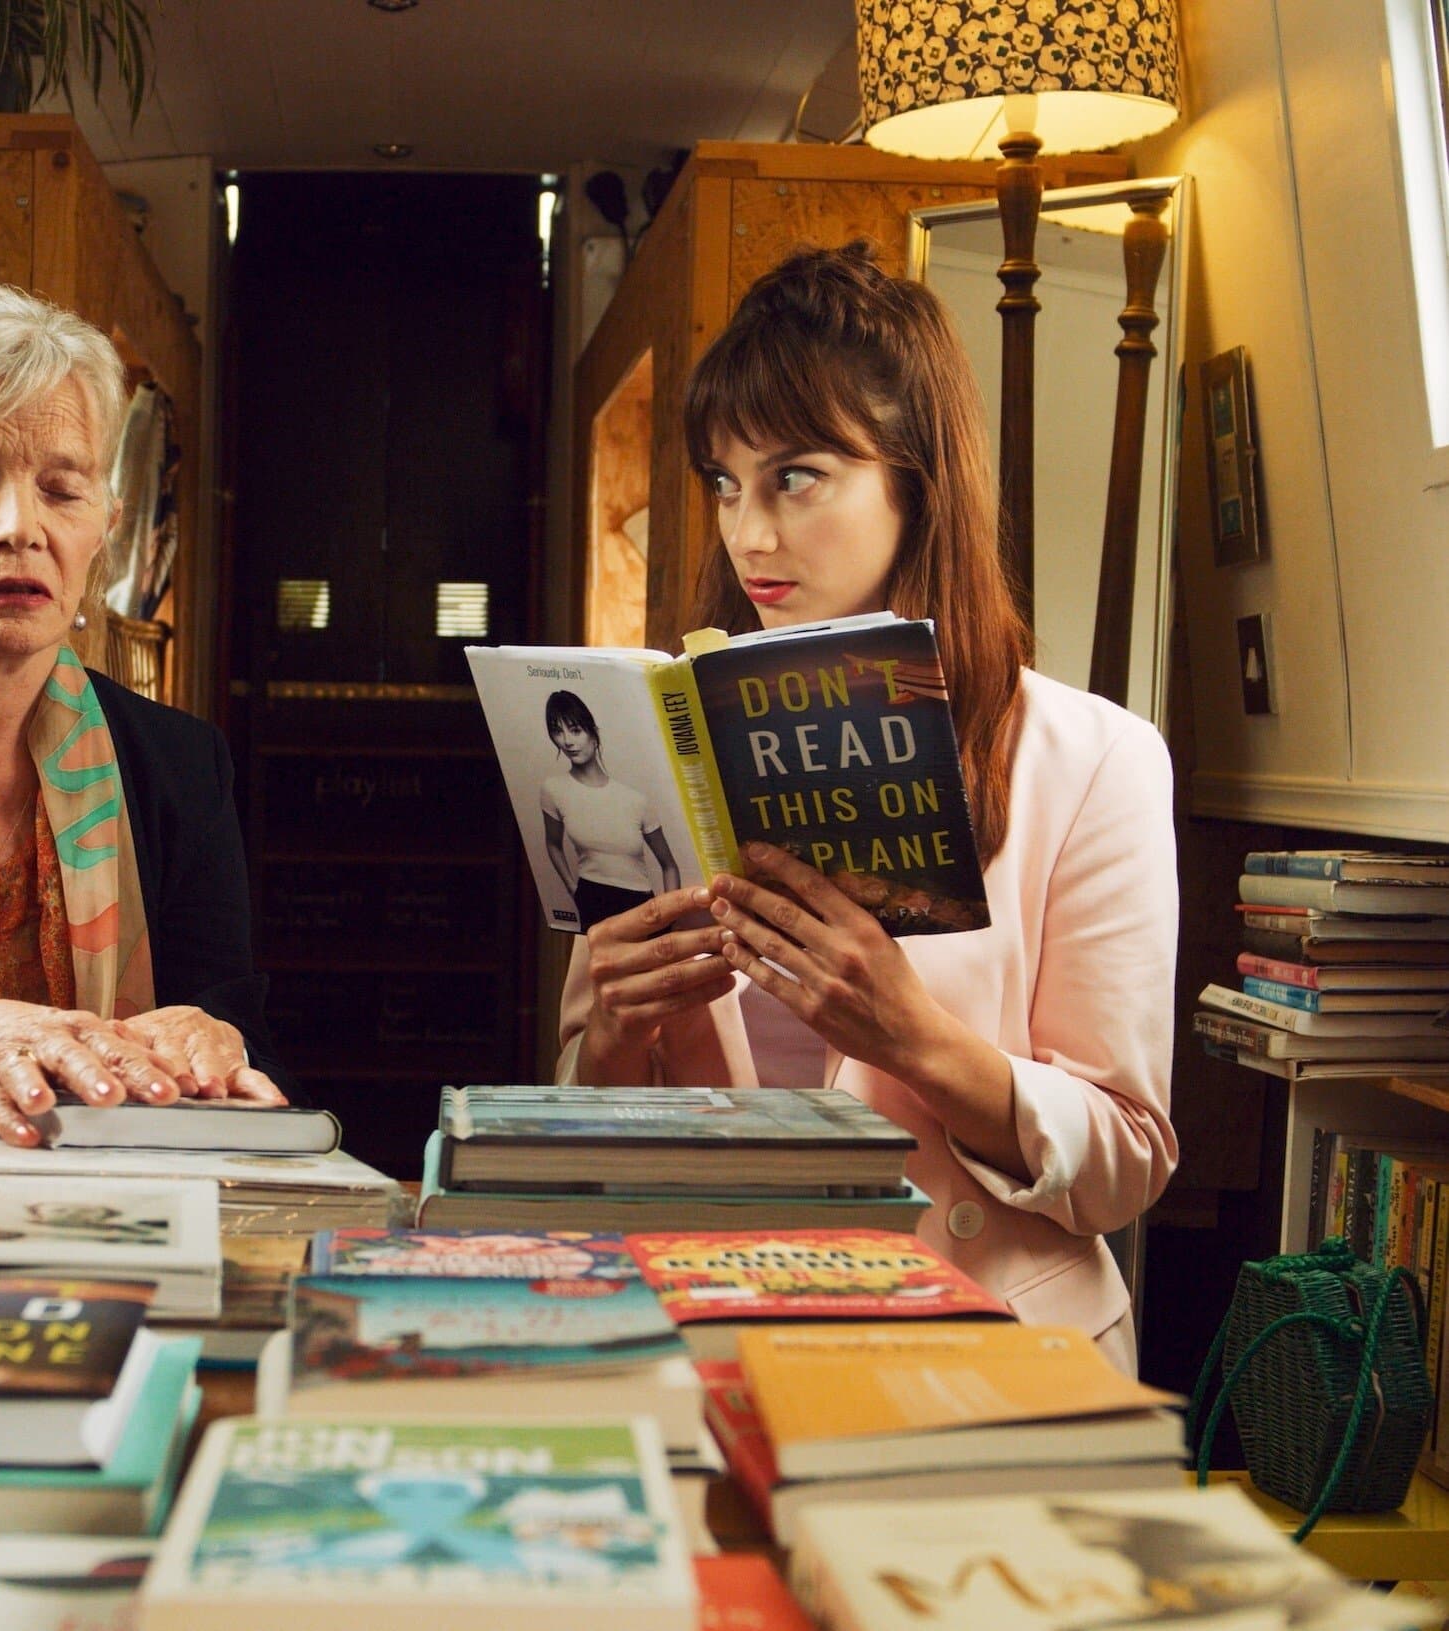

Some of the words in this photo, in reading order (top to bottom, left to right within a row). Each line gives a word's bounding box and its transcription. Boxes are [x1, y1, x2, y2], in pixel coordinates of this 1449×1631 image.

[662, 692, 692, 714] FEY
[738, 659, 899, 718] DON'T
[669, 713, 700, 756] JOVANA
[748, 715, 916, 777] READ
[680, 761, 712, 799] PLANE
[750, 787, 859, 830] THIS
[879, 778, 939, 819] ON
[700, 828, 725, 855] THIS
[811, 830, 955, 874] PLANE
[899, 907, 930, 918] FEY
